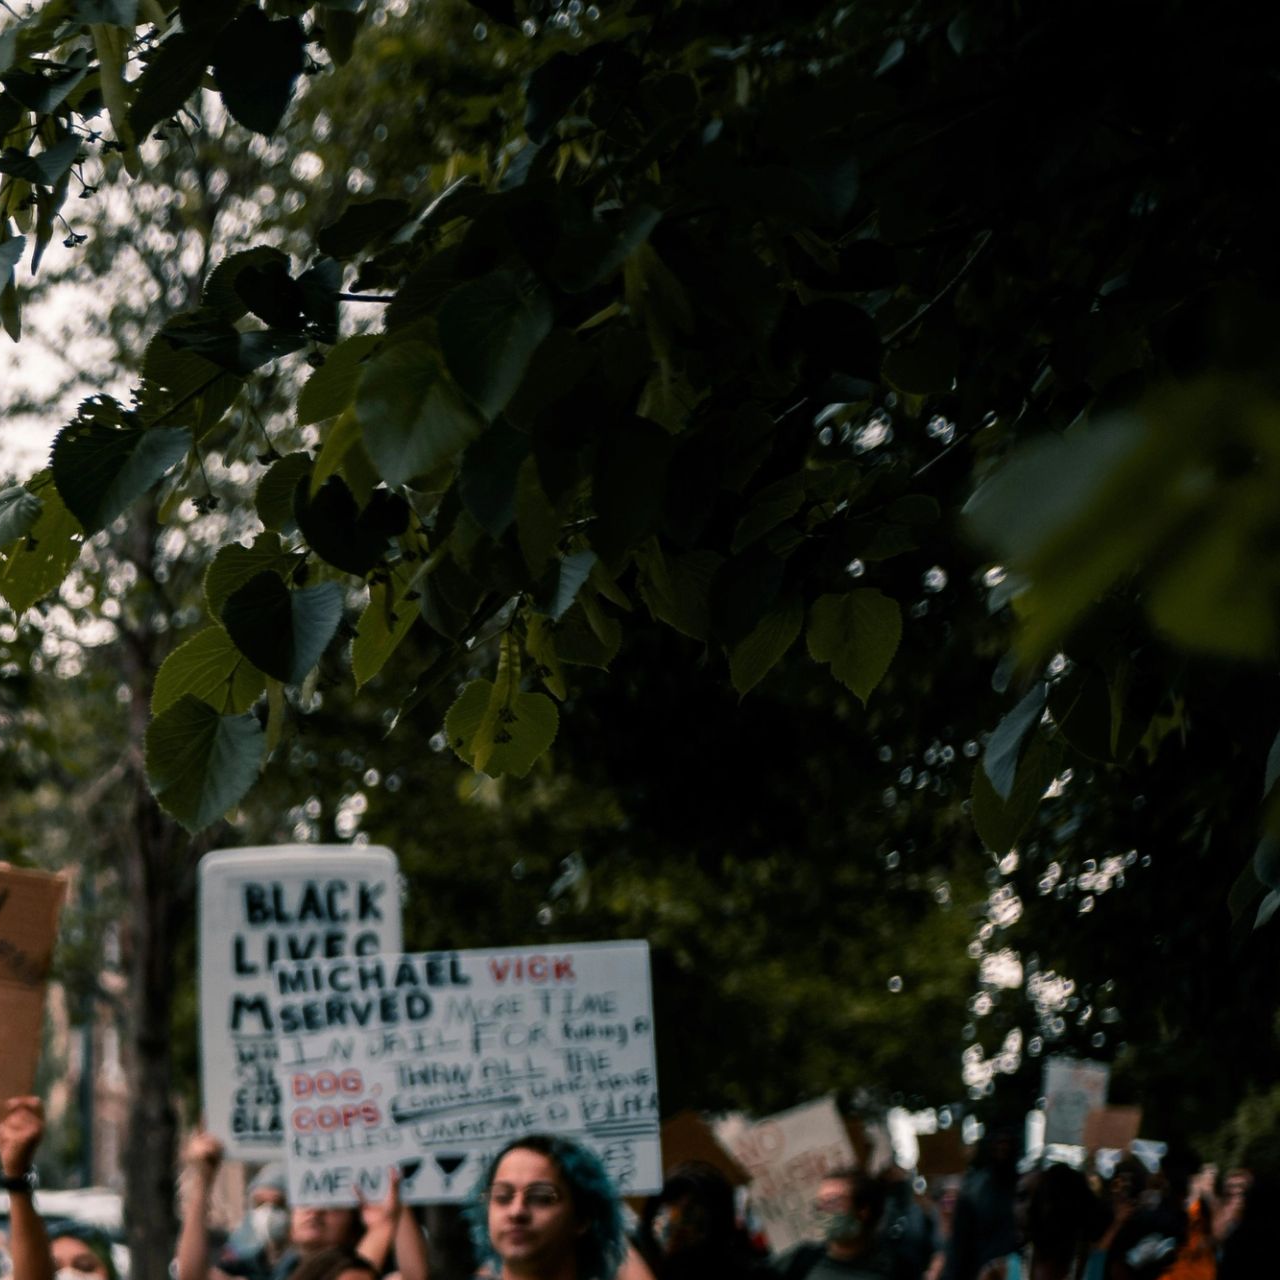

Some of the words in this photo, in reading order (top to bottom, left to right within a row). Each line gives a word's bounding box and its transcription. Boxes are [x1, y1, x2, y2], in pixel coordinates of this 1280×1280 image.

[243, 878, 385, 926] BLACK
[277, 950, 472, 995] MICHAEL
[487, 954, 578, 984] VICK
[280, 991, 434, 1034] SERVED
[291, 1101, 382, 1136] COPS
